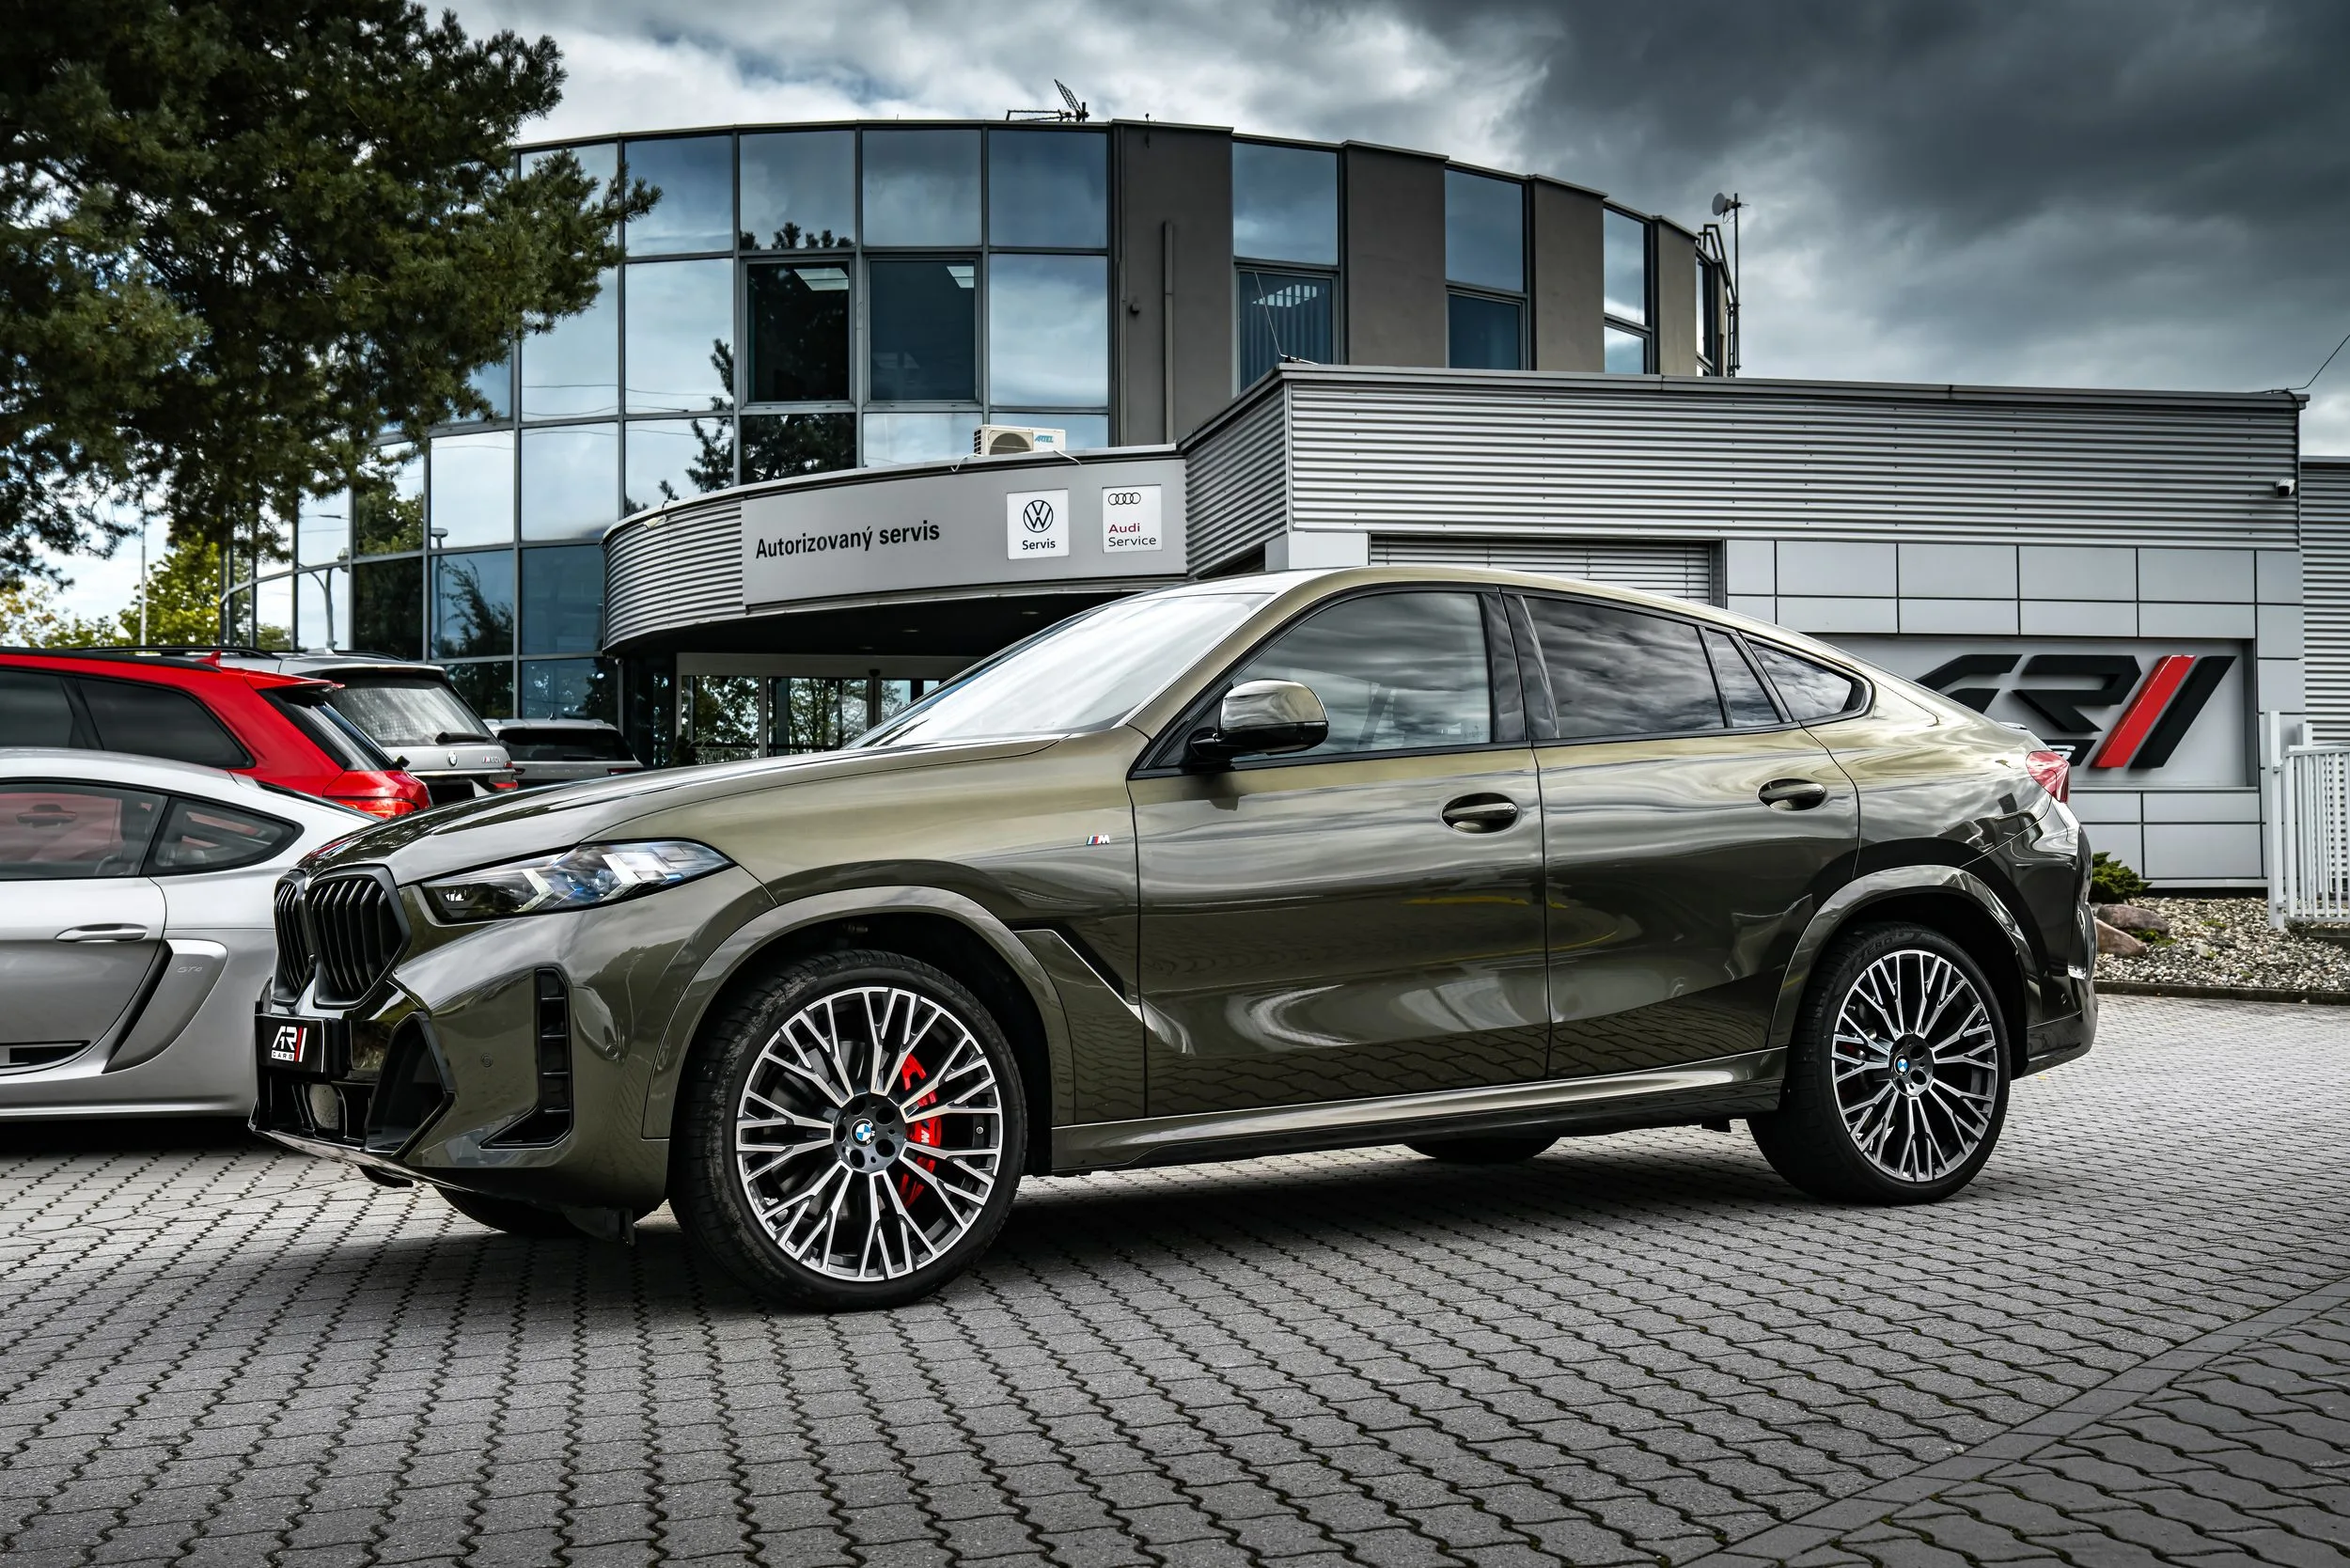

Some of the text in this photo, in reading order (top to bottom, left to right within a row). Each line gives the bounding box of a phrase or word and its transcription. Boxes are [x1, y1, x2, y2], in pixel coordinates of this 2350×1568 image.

[1108, 523, 1140, 534] Audi
[756, 520, 940, 559] Autorizovaný servis
[1022, 539, 1056, 551] Servis
[1108, 536, 1157, 547] Service
[272, 1051, 293, 1060] CARS
